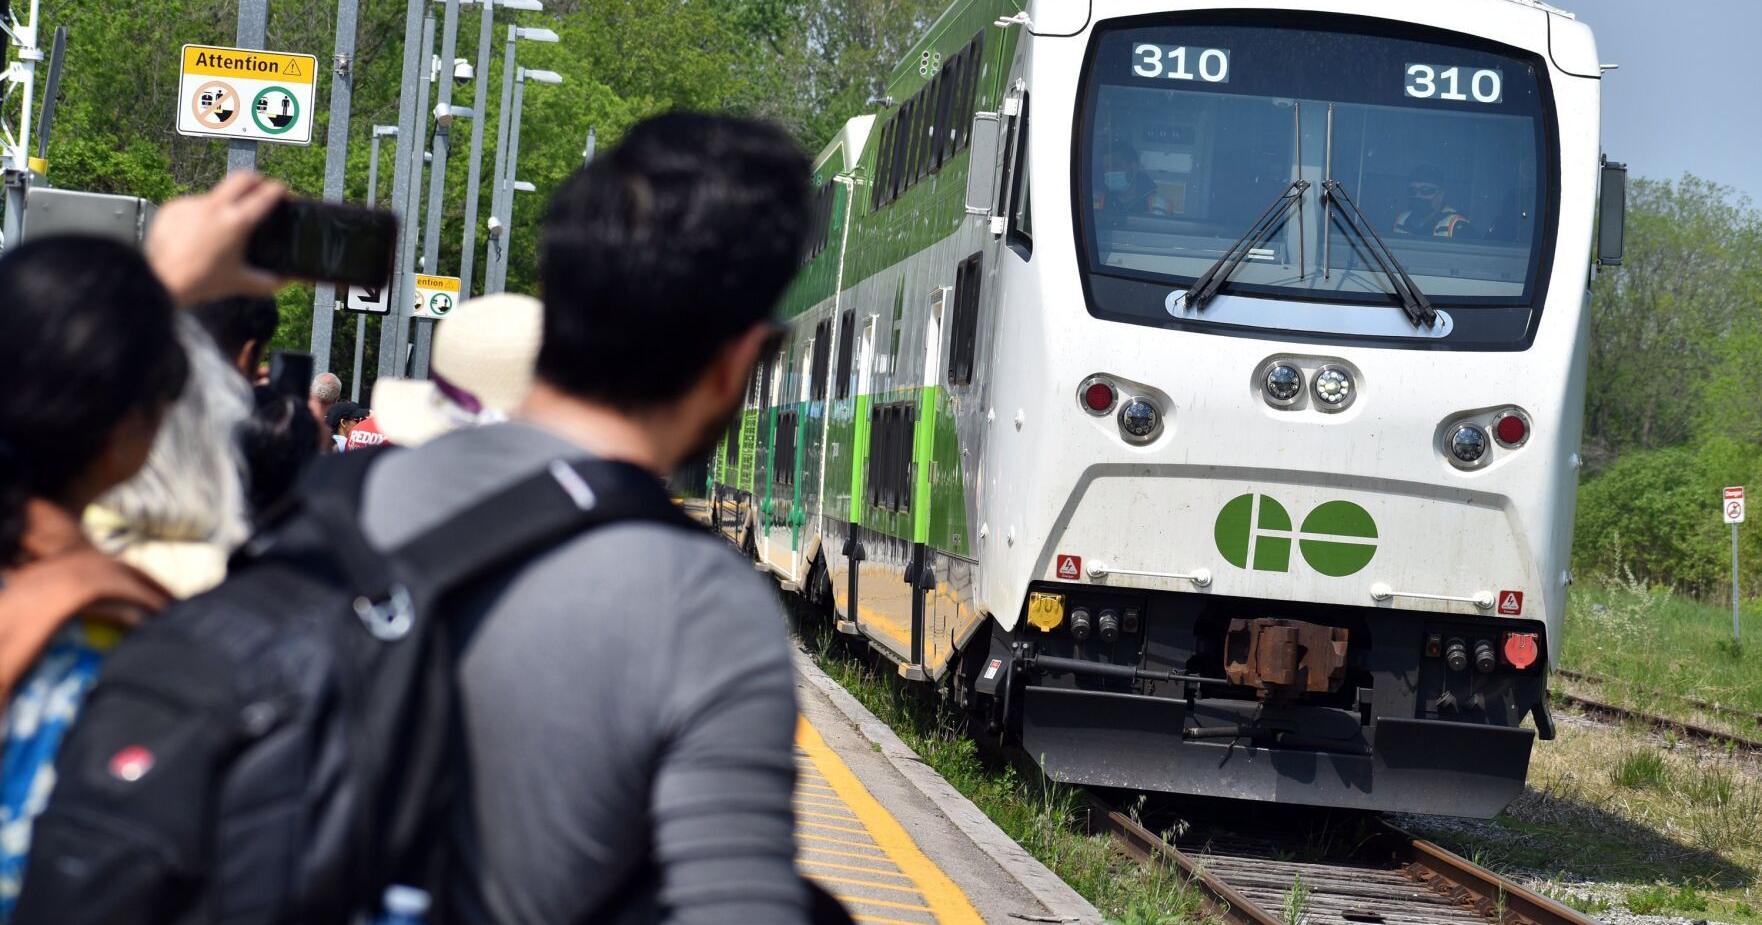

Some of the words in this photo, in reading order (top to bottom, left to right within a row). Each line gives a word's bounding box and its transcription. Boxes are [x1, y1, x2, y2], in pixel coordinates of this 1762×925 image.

[196, 52, 278, 73] Attention
[1134, 44, 1228, 82] 310
[1406, 64, 1500, 103] 310
[417, 279, 444, 287] ention
[1214, 493, 1379, 577] GO
